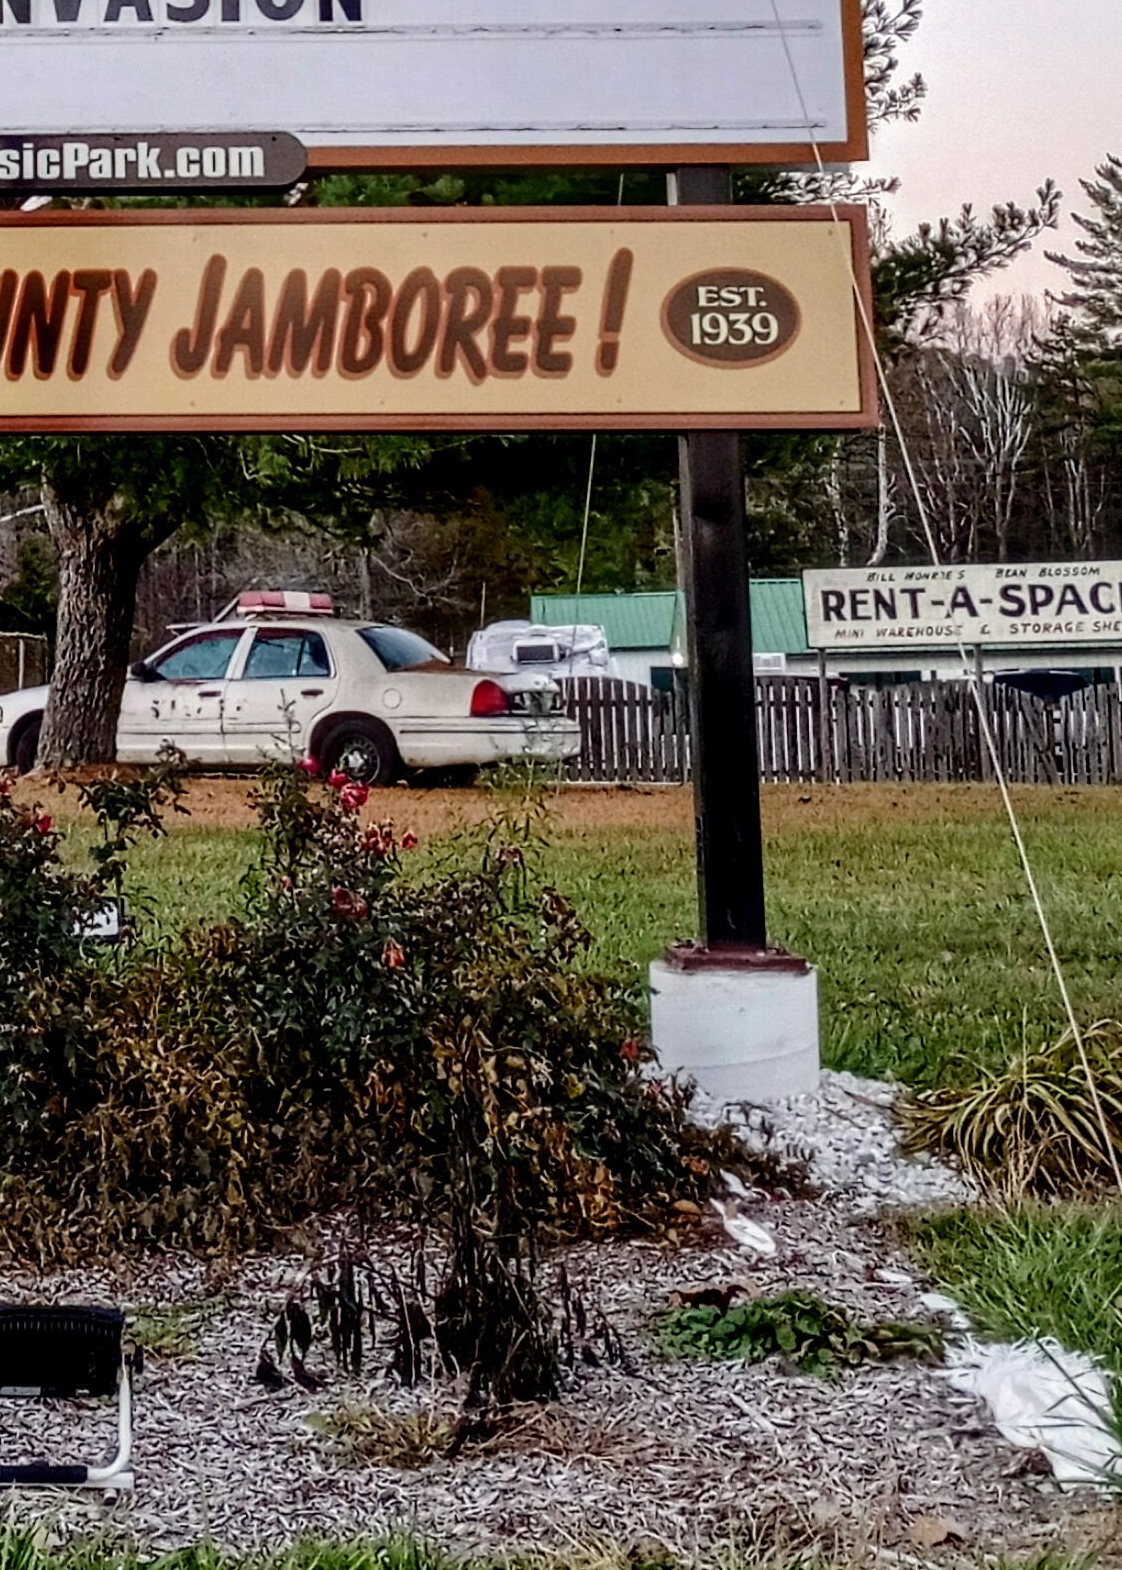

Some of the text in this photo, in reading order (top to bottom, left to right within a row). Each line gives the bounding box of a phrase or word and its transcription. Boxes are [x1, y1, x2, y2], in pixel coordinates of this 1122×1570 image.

[697, 285, 768, 308] EST.
[690, 312, 779, 346] 1939
[866, 572, 896, 582] BILL
[994, 567, 1028, 579] BEAN
[1038, 566, 1101, 578] BLOSSOM
[834, 629, 865, 639] MINI
[876, 625, 963, 638] WAREHOUSE
[1009, 621, 1085, 635] STORAGE
